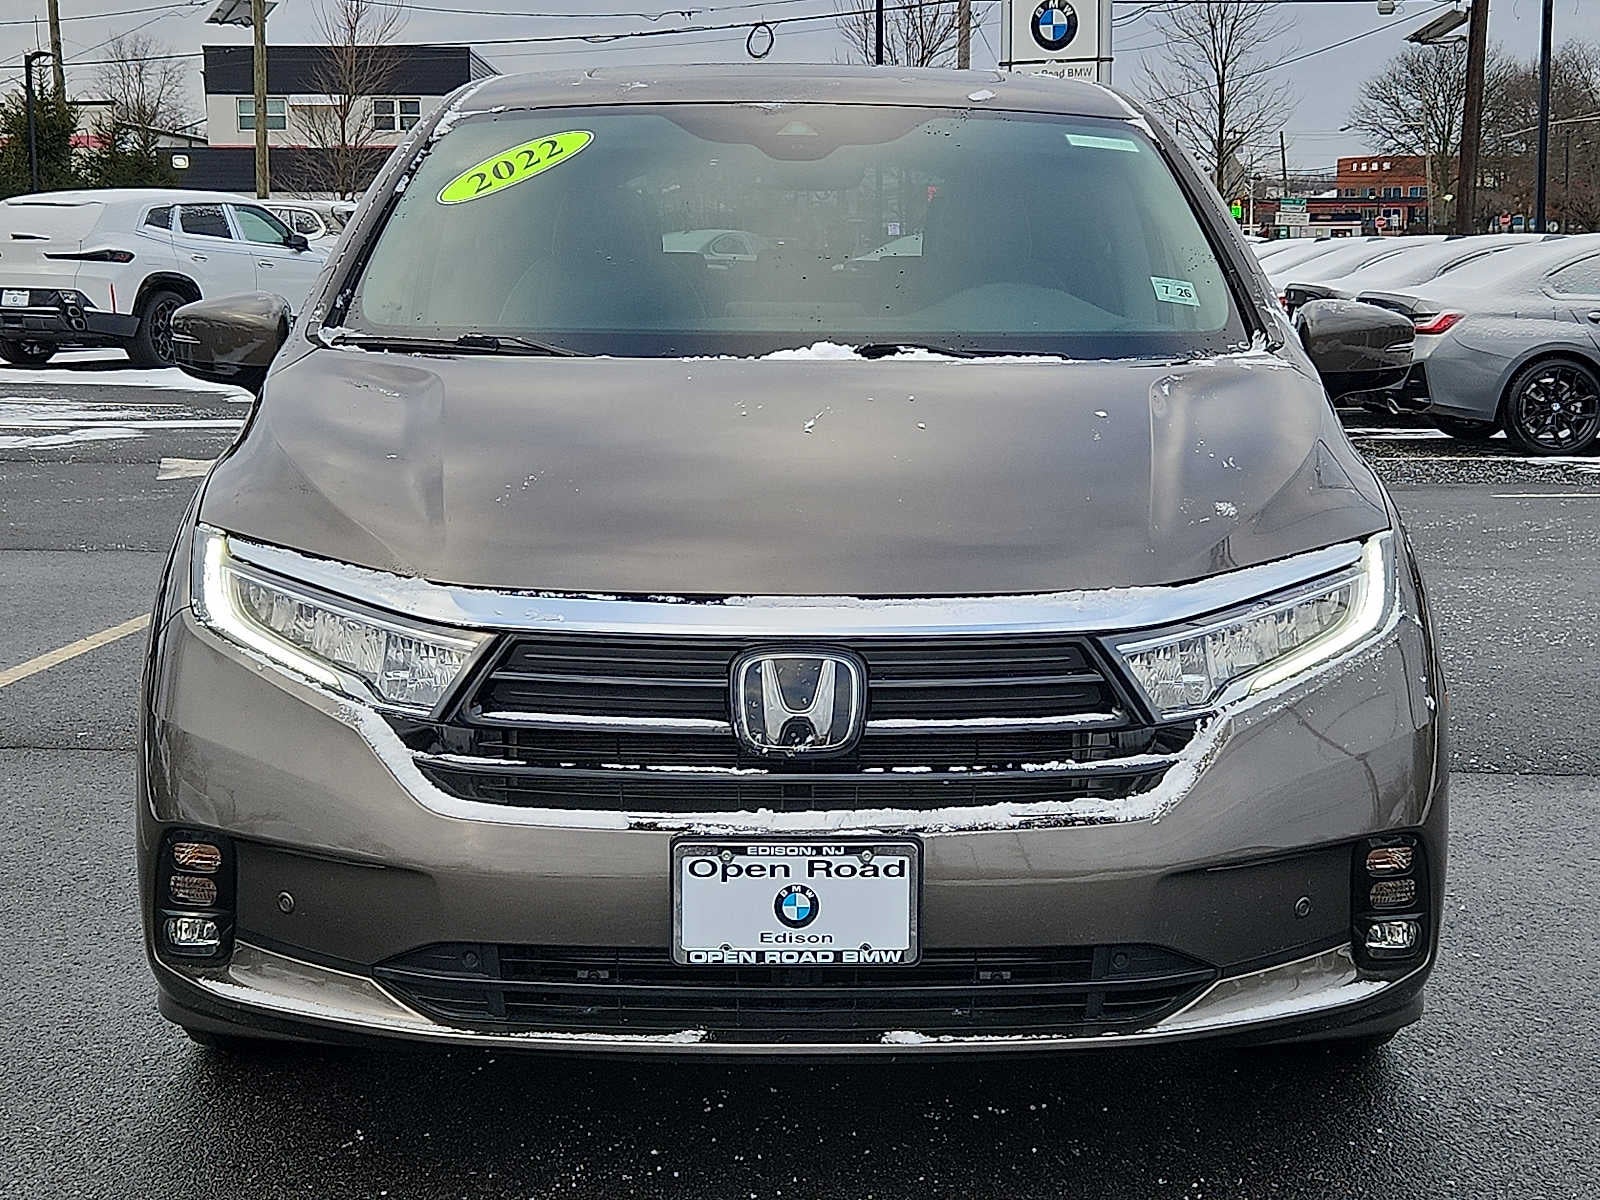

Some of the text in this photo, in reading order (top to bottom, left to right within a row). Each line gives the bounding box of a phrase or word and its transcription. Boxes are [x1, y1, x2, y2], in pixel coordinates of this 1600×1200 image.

[1036, 0, 1074, 17] BMW
[1067, 67, 1092, 78] BMW
[466, 139, 564, 194] 2022
[1162, 285, 1192, 298] 7 26
[747, 846, 845, 857] EDISON, NJ
[688, 858, 906, 882] Open Road
[780, 885, 815, 899] BMW
[759, 932, 833, 944] Edison
[689, 950, 903, 964] OPEN ROAD BMW
